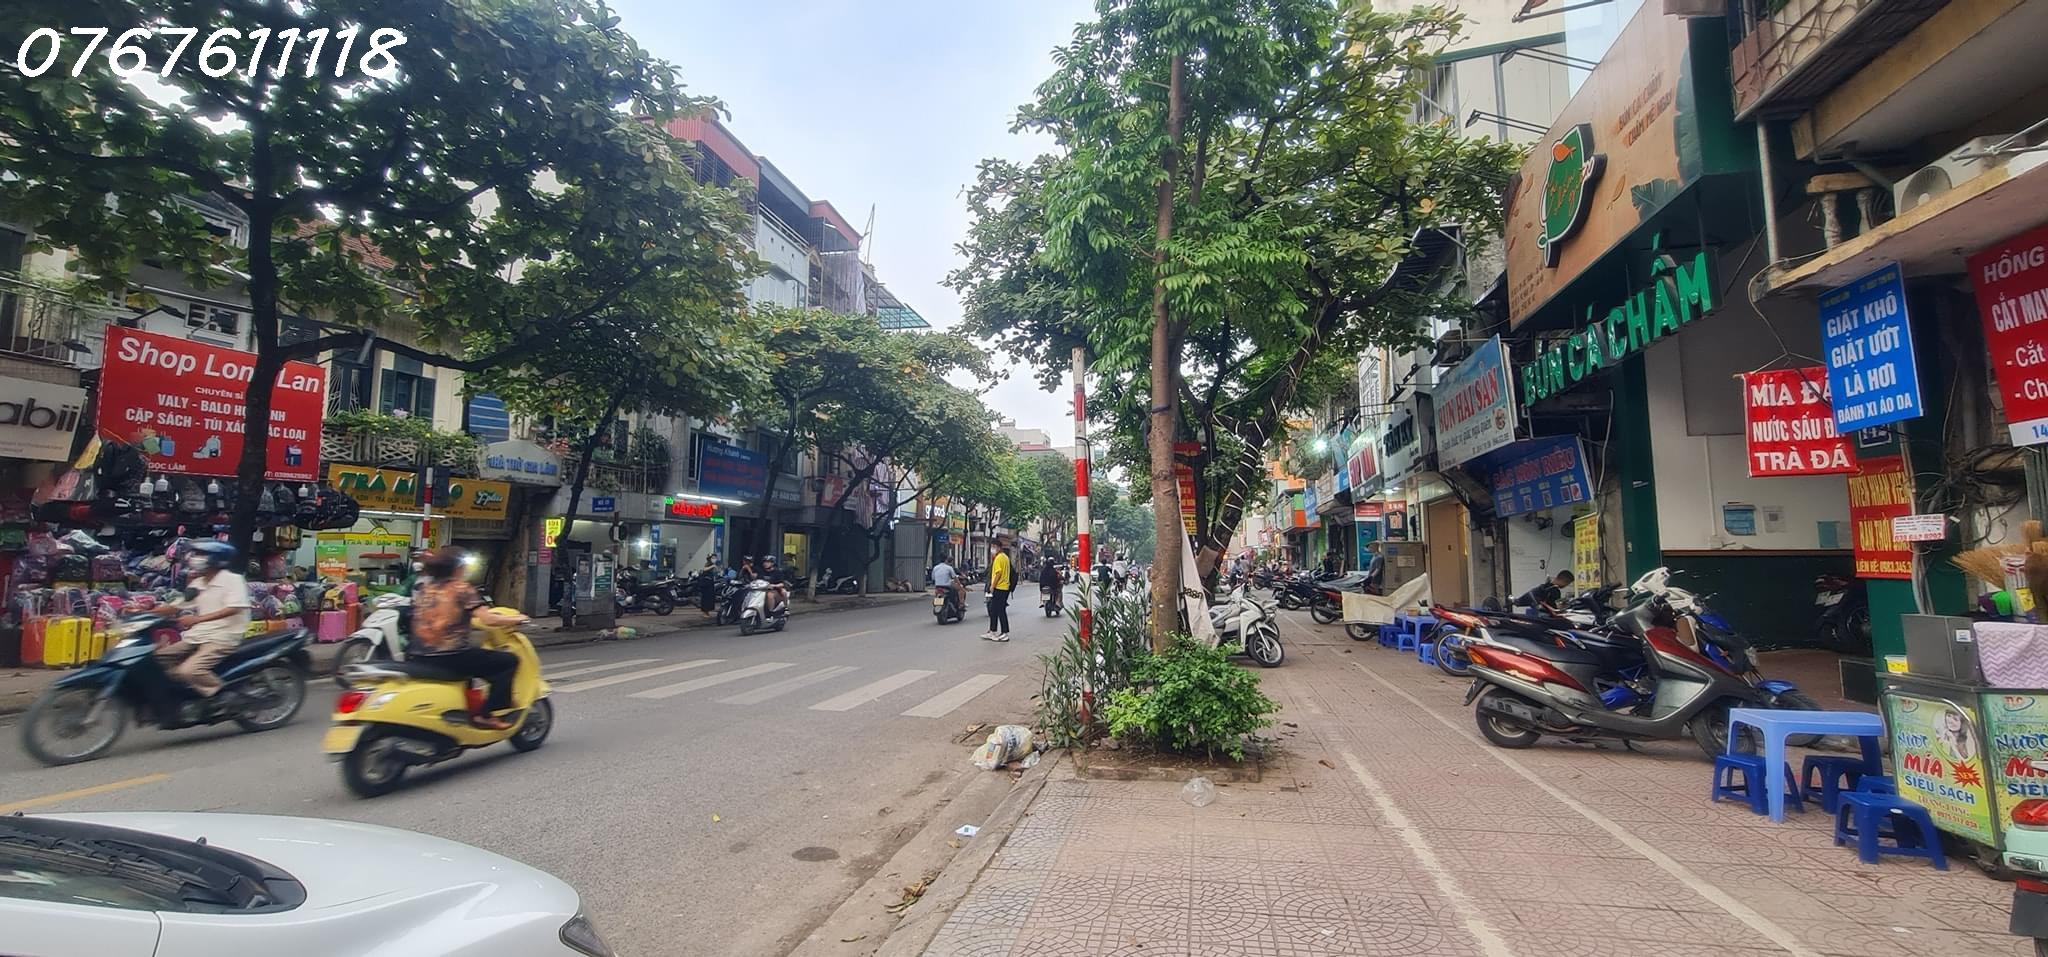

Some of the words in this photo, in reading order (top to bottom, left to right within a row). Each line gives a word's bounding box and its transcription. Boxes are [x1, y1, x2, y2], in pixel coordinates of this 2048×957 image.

[1983, 245, 2046, 284] HỒNG
[1567, 303, 1604, 382] CÁ
[1607, 232, 1712, 360] CHẤM
[1827, 307, 1860, 339] GIẶT
[1863, 290, 1898, 325] KHÔ
[1991, 292, 2020, 333] CẮT
[1831, 338, 1865, 369] GIẶT
[1868, 323, 1901, 357] ƯỚT
[2015, 339, 2047, 368] Cắt
[118, 336, 197, 377] Shop
[204, 353, 255, 383] Lon
[277, 367, 320, 393] Lan
[1844, 368, 1865, 398] LÀ
[1867, 362, 1897, 392] HƠI
[157, 393, 190, 409] VALY
[200, 400, 231, 416] BALO
[195, 386, 234, 399] CHUYÊN
[1751, 379, 1796, 408] MÍA
[1837, 403, 1866, 425] ĐÁNH
[1867, 401, 1878, 417] XI
[1896, 392, 1913, 410] DA
[125, 408, 153, 422] CẶP
[157, 411, 192, 428] SÁCH
[282, 428, 307, 443] LOẠI
[1752, 415, 1790, 443] NƯỚC
[1791, 411, 1821, 442] SẤU
[1754, 446, 1806, 471] TRÀ
[1810, 443, 1851, 470] ĐÁ
[338, 468, 386, 490] TRÀ
[1539, 559, 1546, 570] 3
[1903, 752, 1943, 779] MÍA
[1904, 774, 1935, 792] SIÊU
[1939, 784, 1976, 805] SẠCH
[2007, 781, 2048, 796] SIÊ
